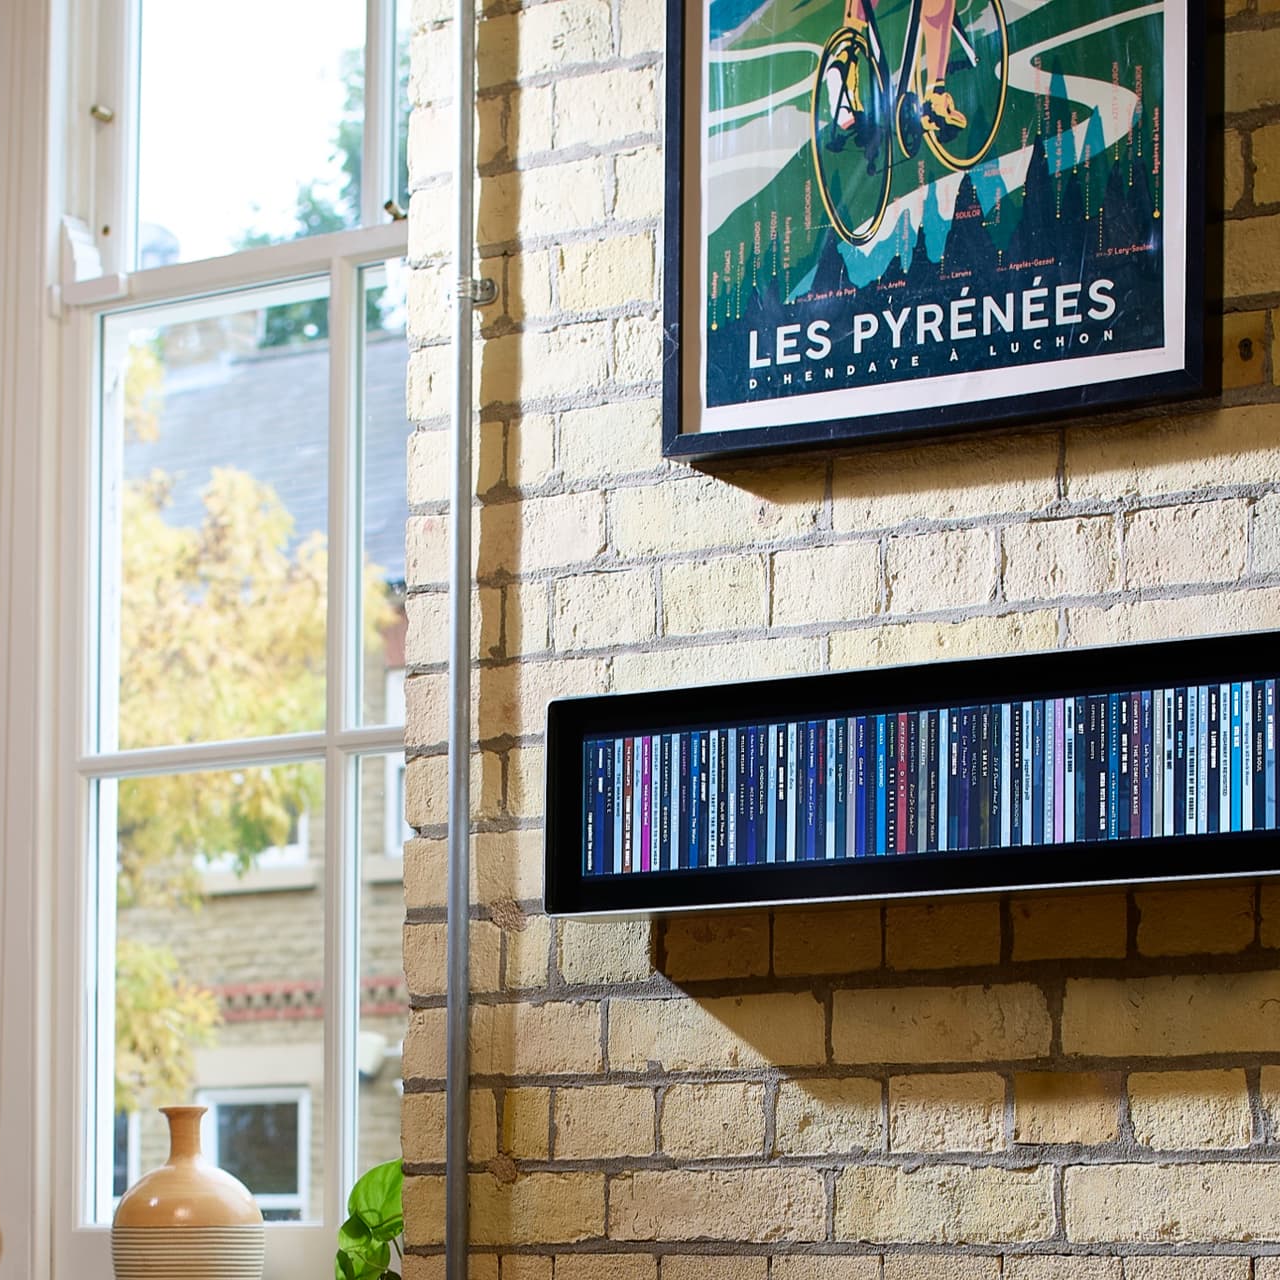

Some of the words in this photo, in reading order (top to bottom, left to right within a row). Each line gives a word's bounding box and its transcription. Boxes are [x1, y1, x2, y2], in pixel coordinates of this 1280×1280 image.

[955, 209, 981, 219] SOULOR
[749, 319, 832, 369] LES
[852, 276, 1116, 354] PYRÉNÉES
[749, 355, 920, 390] D'HENDAYE
[948, 348, 958, 361] À
[990, 328, 1114, 356] LUCHON
